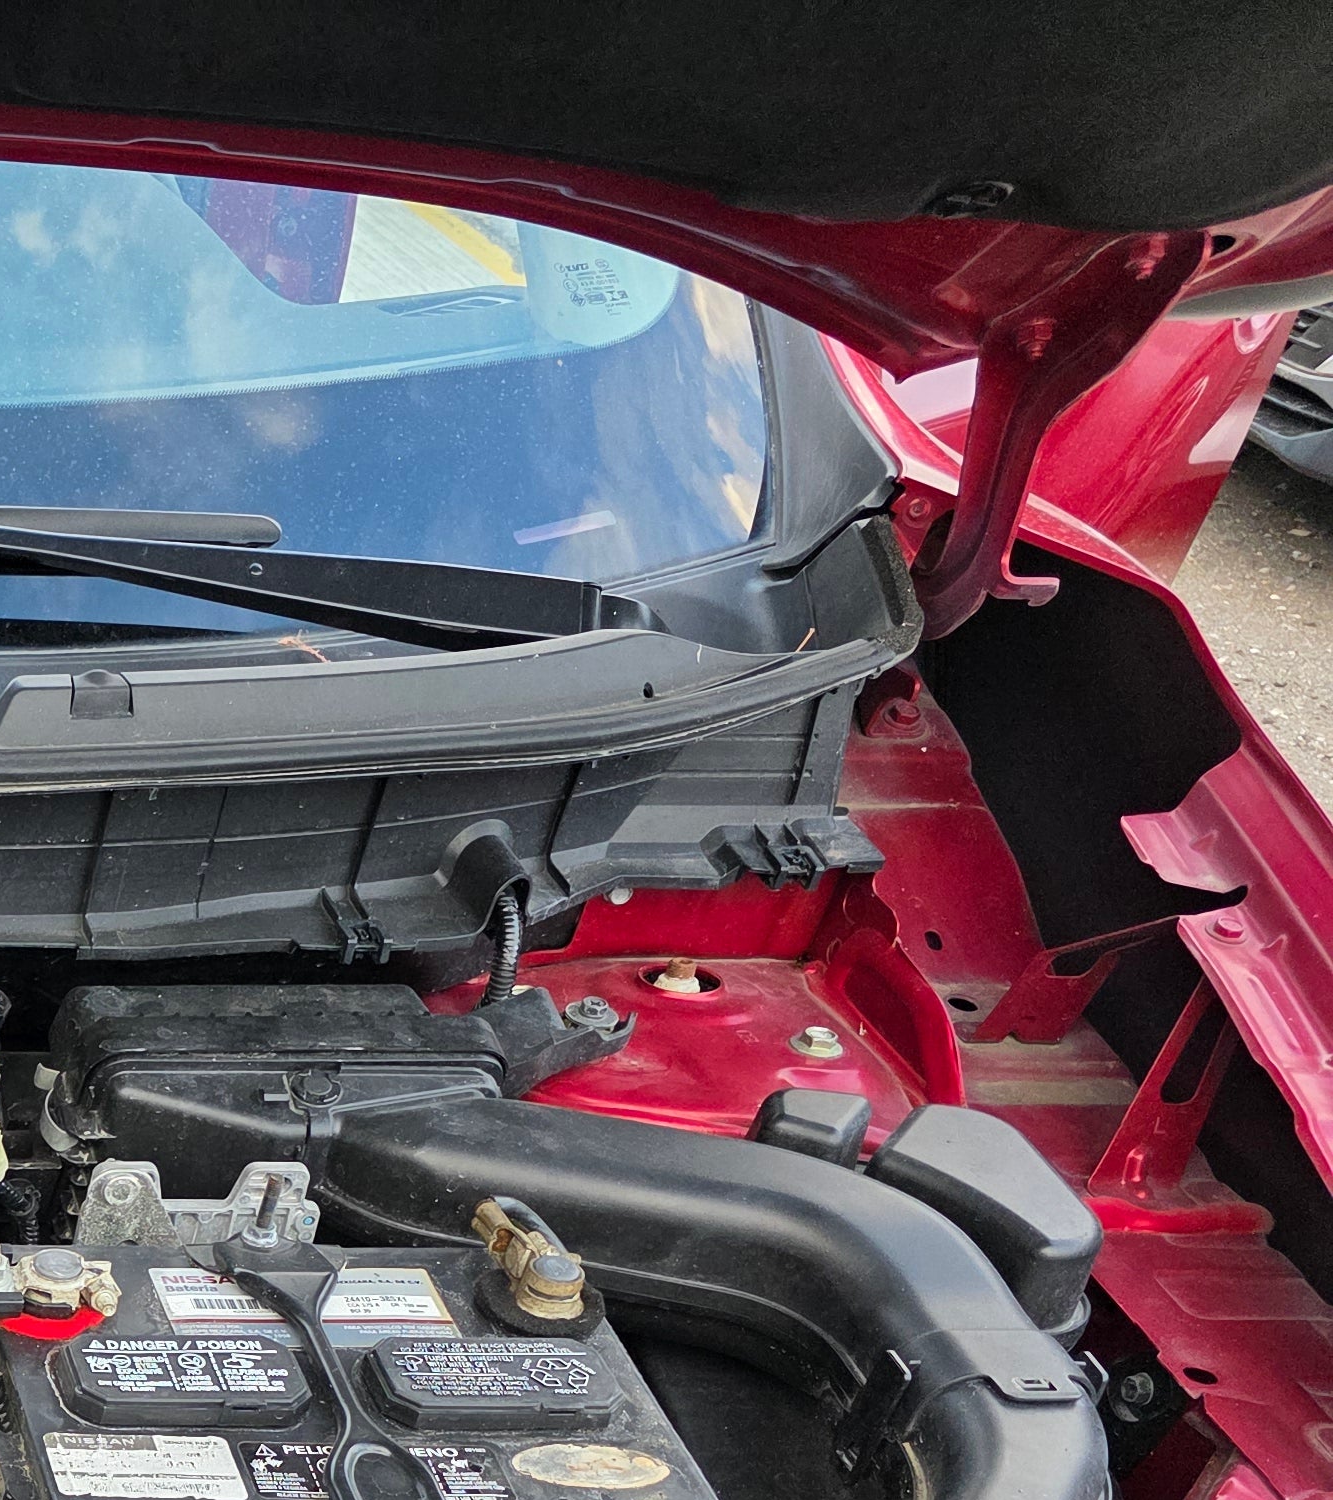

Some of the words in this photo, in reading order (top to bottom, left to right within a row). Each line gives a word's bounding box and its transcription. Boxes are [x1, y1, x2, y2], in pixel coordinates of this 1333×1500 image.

[161, 1275, 236, 1285] NISSA
[105, 1340, 179, 1351] DANGER
[196, 1340, 263, 1351] POISON
[64, 1435, 135, 1446] NISSAN
